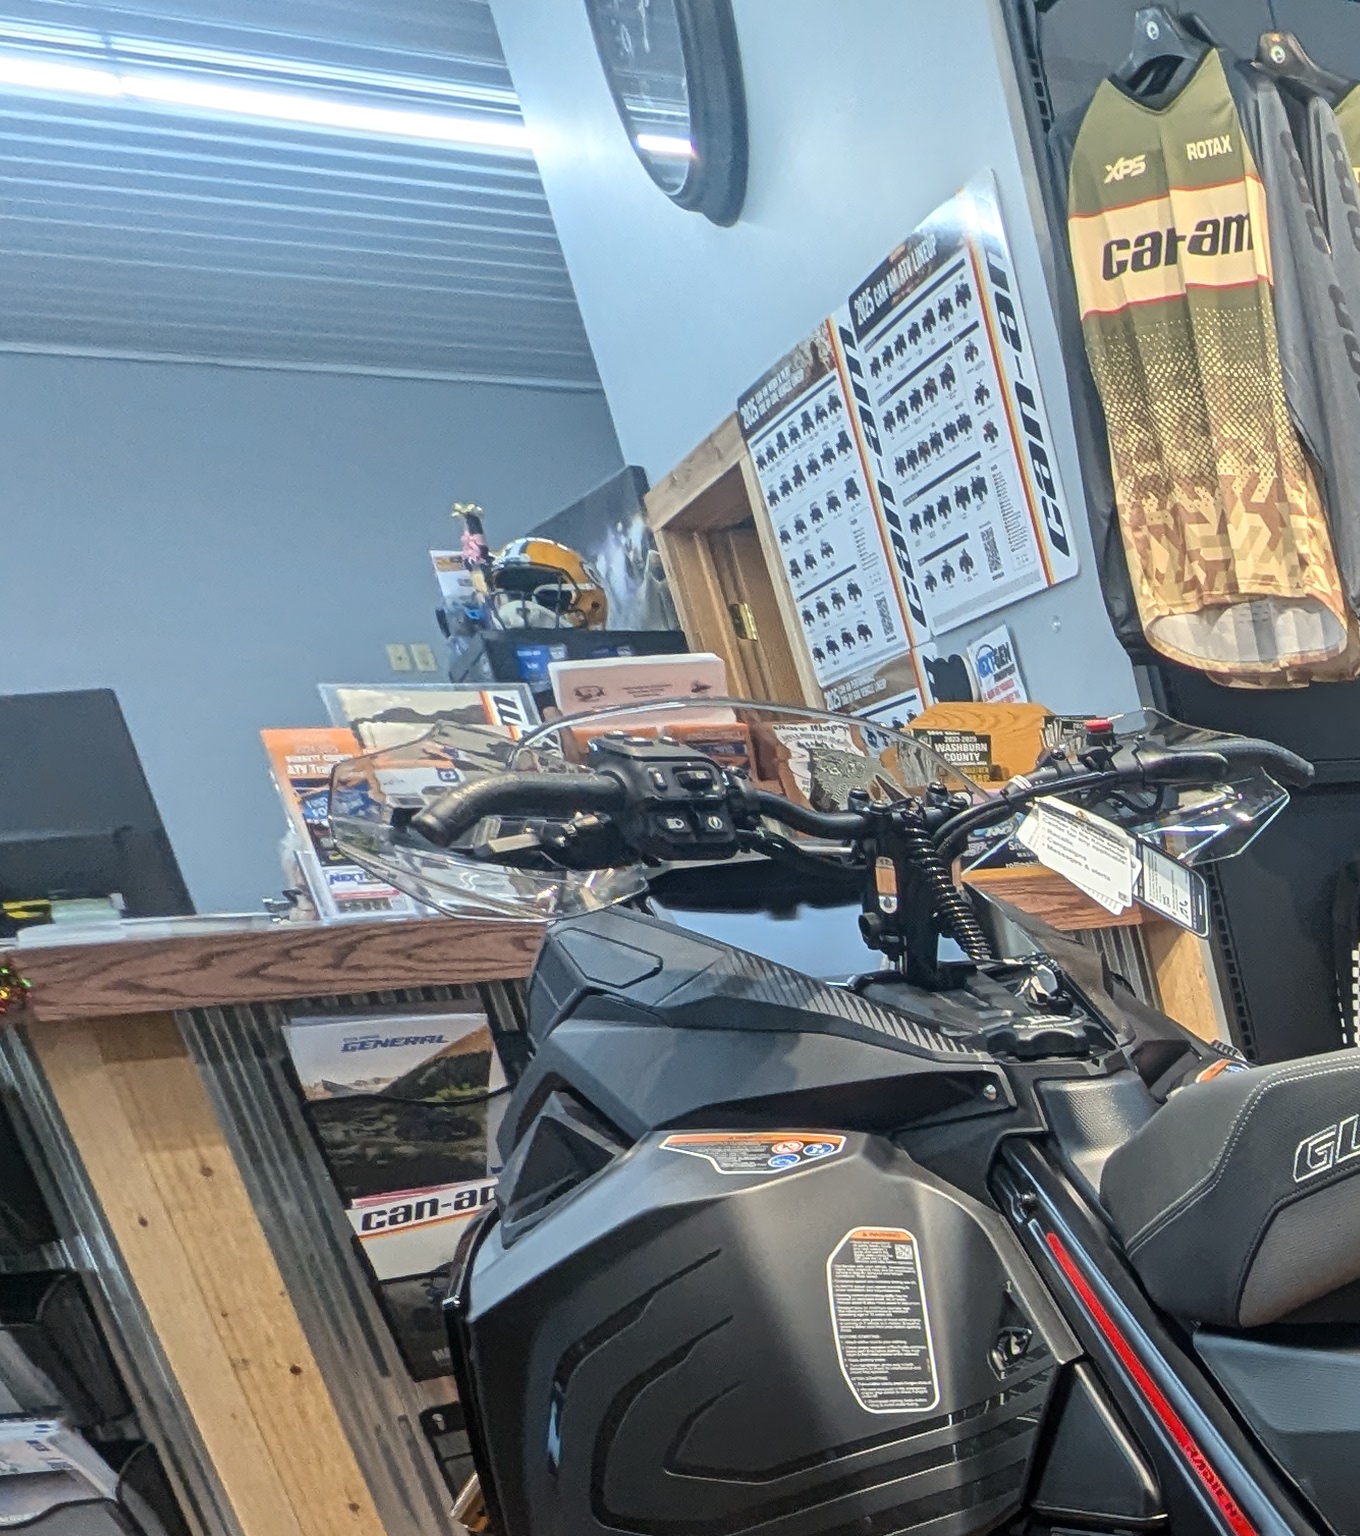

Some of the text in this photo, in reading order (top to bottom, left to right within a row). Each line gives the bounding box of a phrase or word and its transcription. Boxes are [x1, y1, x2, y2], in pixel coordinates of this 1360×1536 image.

[1187, 134, 1233, 161] ROTAX
[1104, 155, 1147, 183] XPS
[935, 743, 987, 752] WASHBURN
[944, 753, 980, 761] COUNTY
[287, 764, 306, 774] ATV
[342, 1034, 449, 1052] GENERAL
